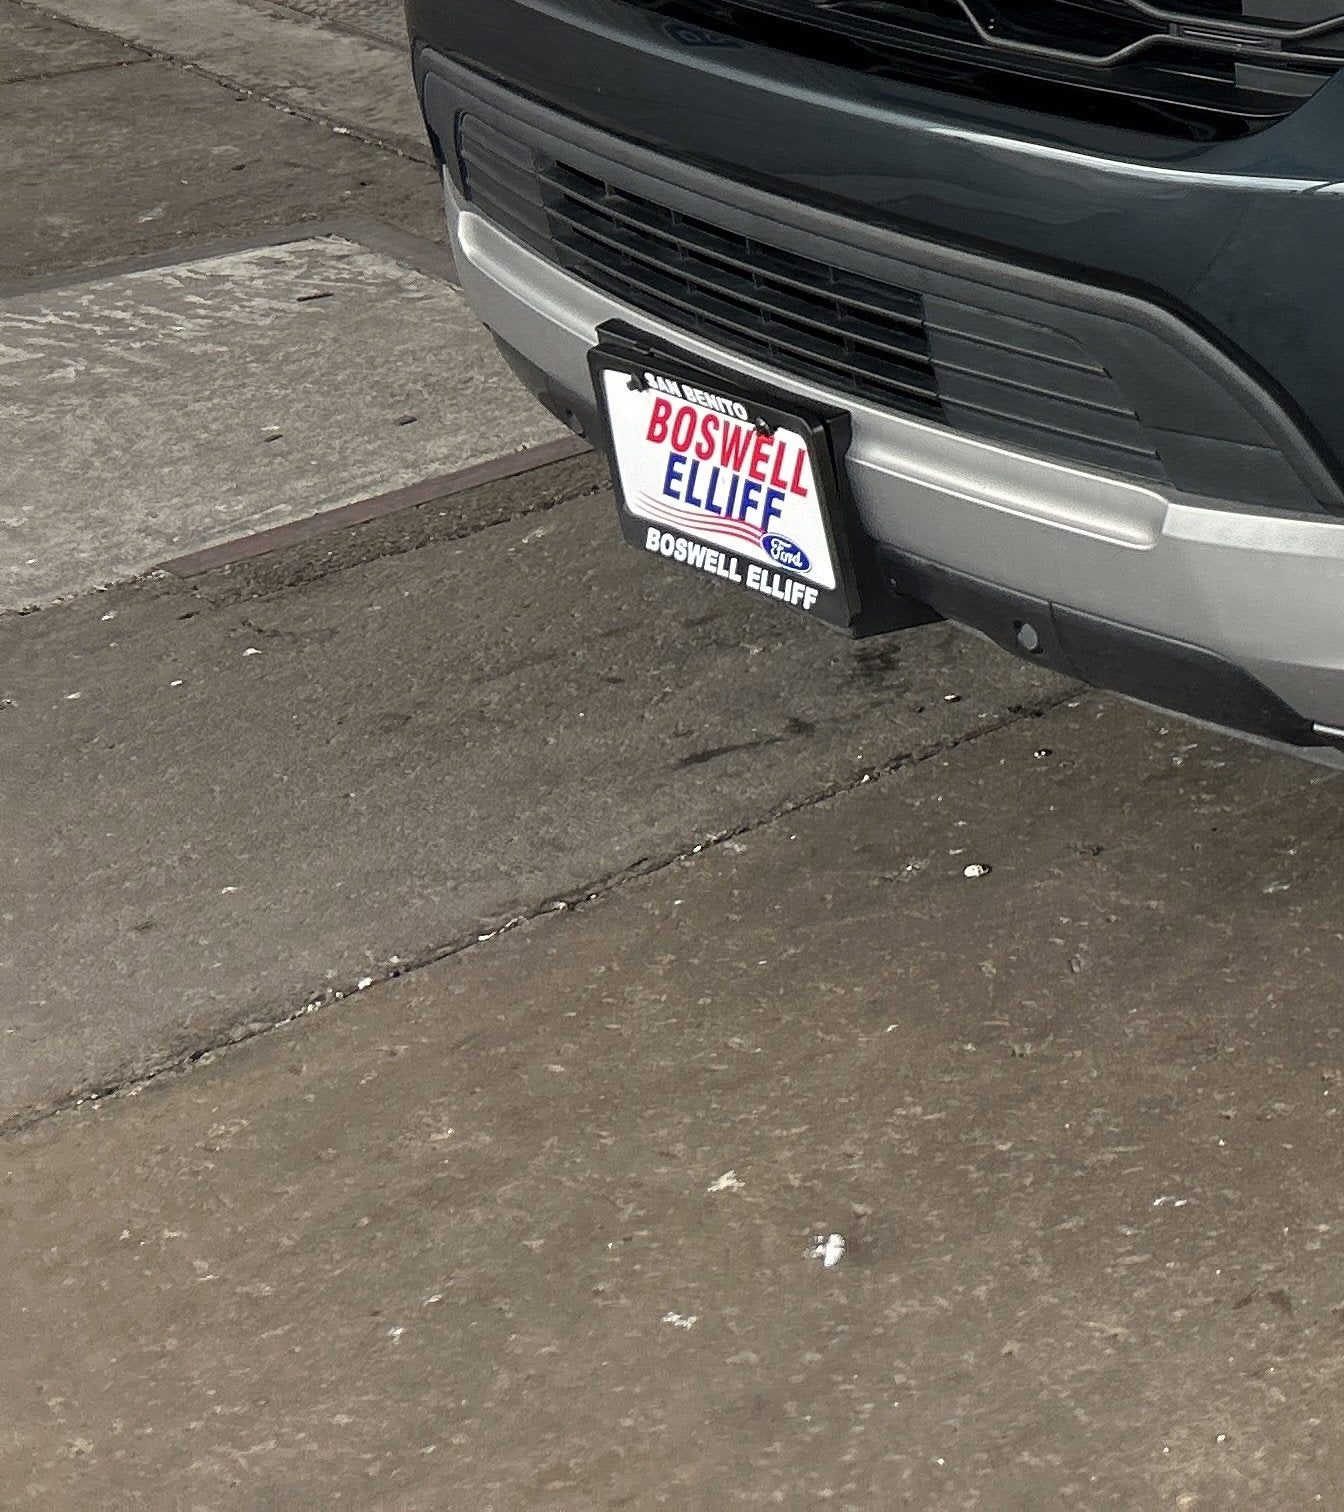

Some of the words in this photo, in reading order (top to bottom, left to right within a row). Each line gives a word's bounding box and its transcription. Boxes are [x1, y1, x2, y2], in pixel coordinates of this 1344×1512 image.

[643, 371, 683, 399] SAN
[681, 384, 748, 421] BENITO
[646, 396, 810, 498] BOSWELL
[662, 450, 786, 532] ELLIFF
[645, 526, 742, 584] BOSWELL
[745, 563, 819, 611] ELLIFF
[769, 538, 804, 569] Ford
